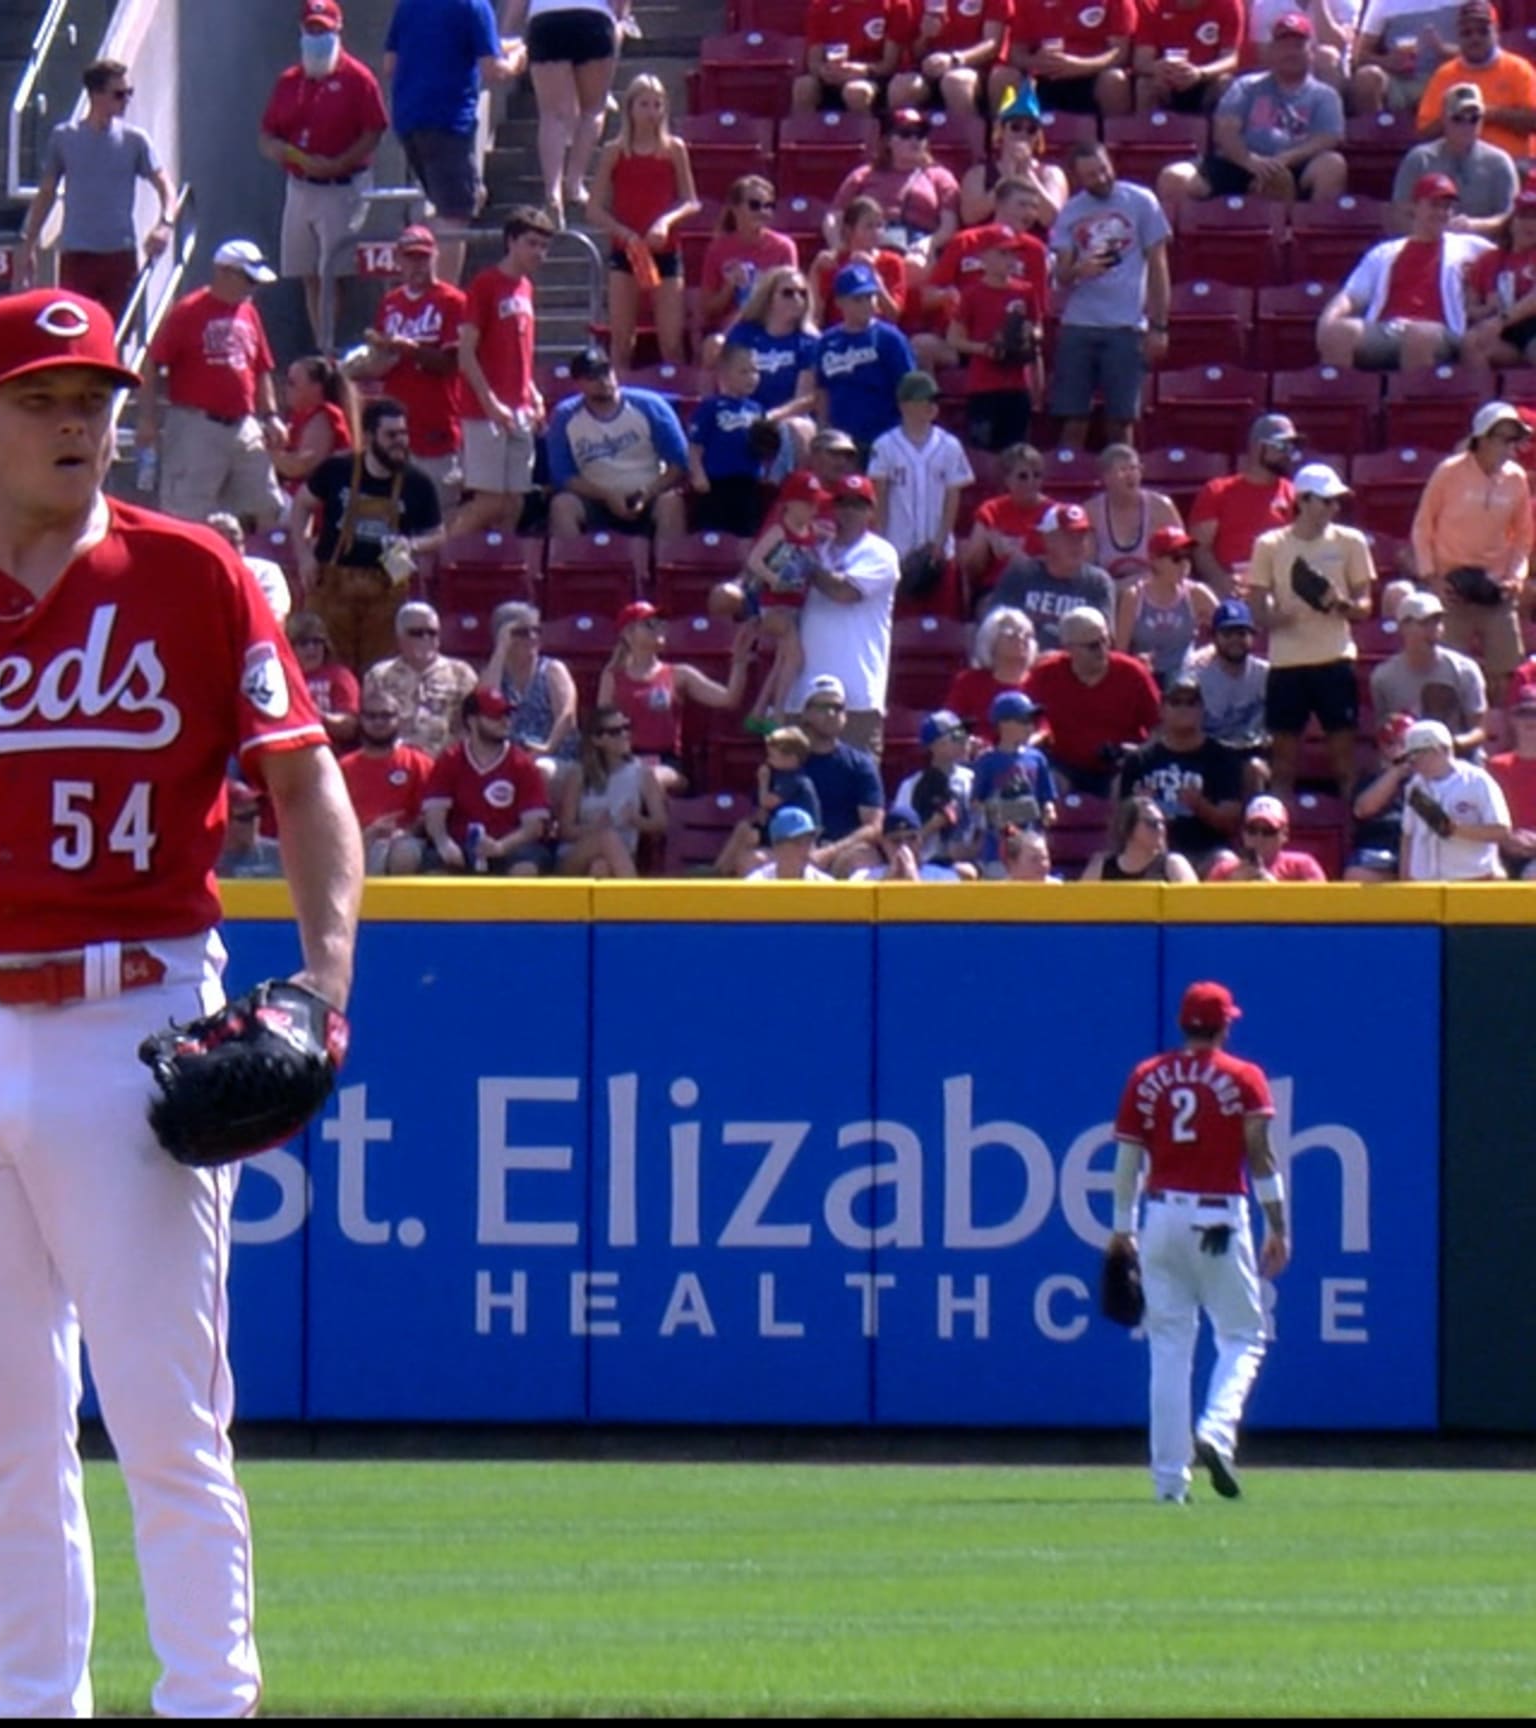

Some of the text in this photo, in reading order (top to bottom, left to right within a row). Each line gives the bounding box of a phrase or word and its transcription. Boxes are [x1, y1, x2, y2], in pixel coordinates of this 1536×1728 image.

[365, 248, 401, 273] 14
[385, 303, 443, 341] Reds
[51, 780, 156, 872] 54
[1169, 1087, 1198, 1143] 2
[476, 1072, 1371, 1252] Elizabeh
[475, 1269, 1369, 1343] HEALTHCE
